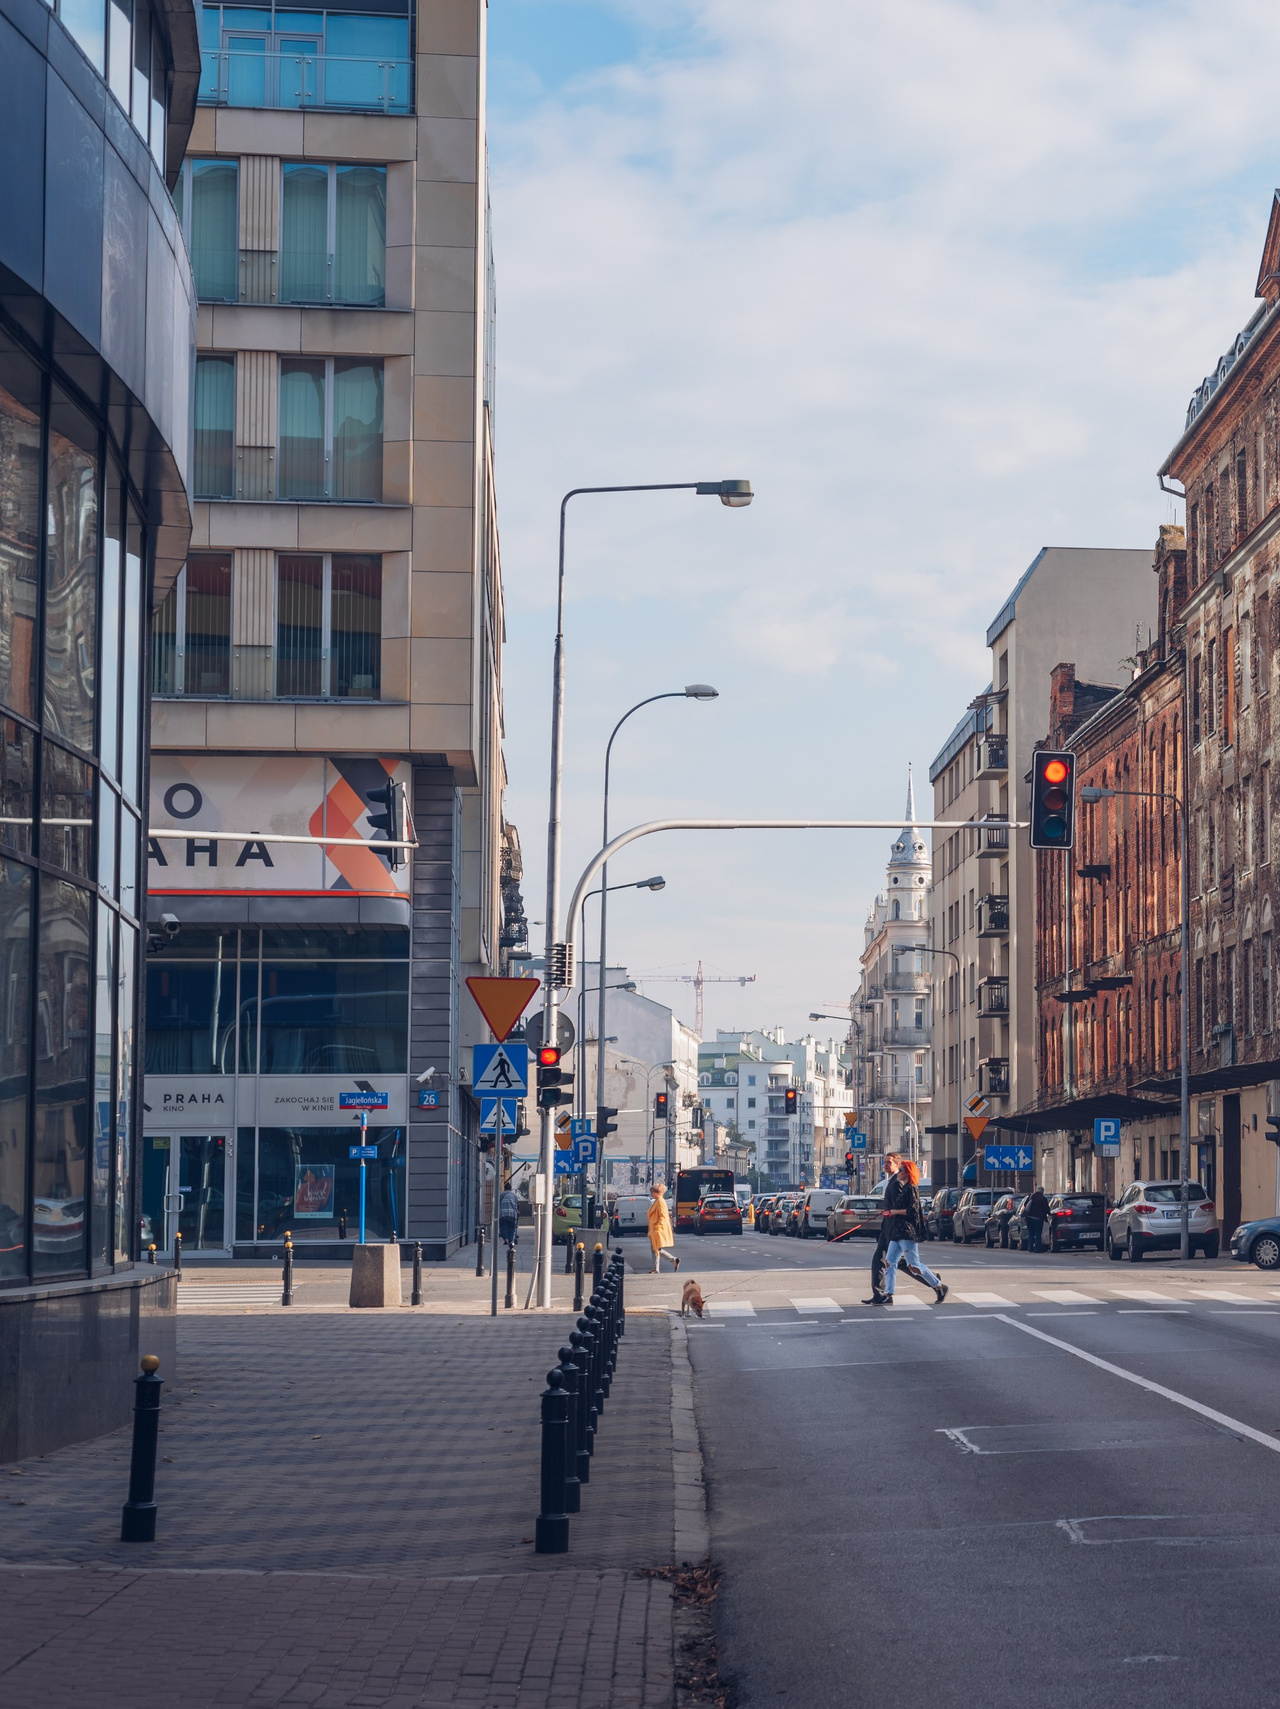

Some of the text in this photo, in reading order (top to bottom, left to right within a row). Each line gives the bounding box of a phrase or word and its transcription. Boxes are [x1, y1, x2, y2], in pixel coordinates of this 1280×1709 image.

[163, 1093, 225, 1104] PRAHA
[274, 1096, 320, 1104] ZAKOCHAJ
[345, 1096, 383, 1106] Jagiellońska
[423, 1094, 436, 1105] 26
